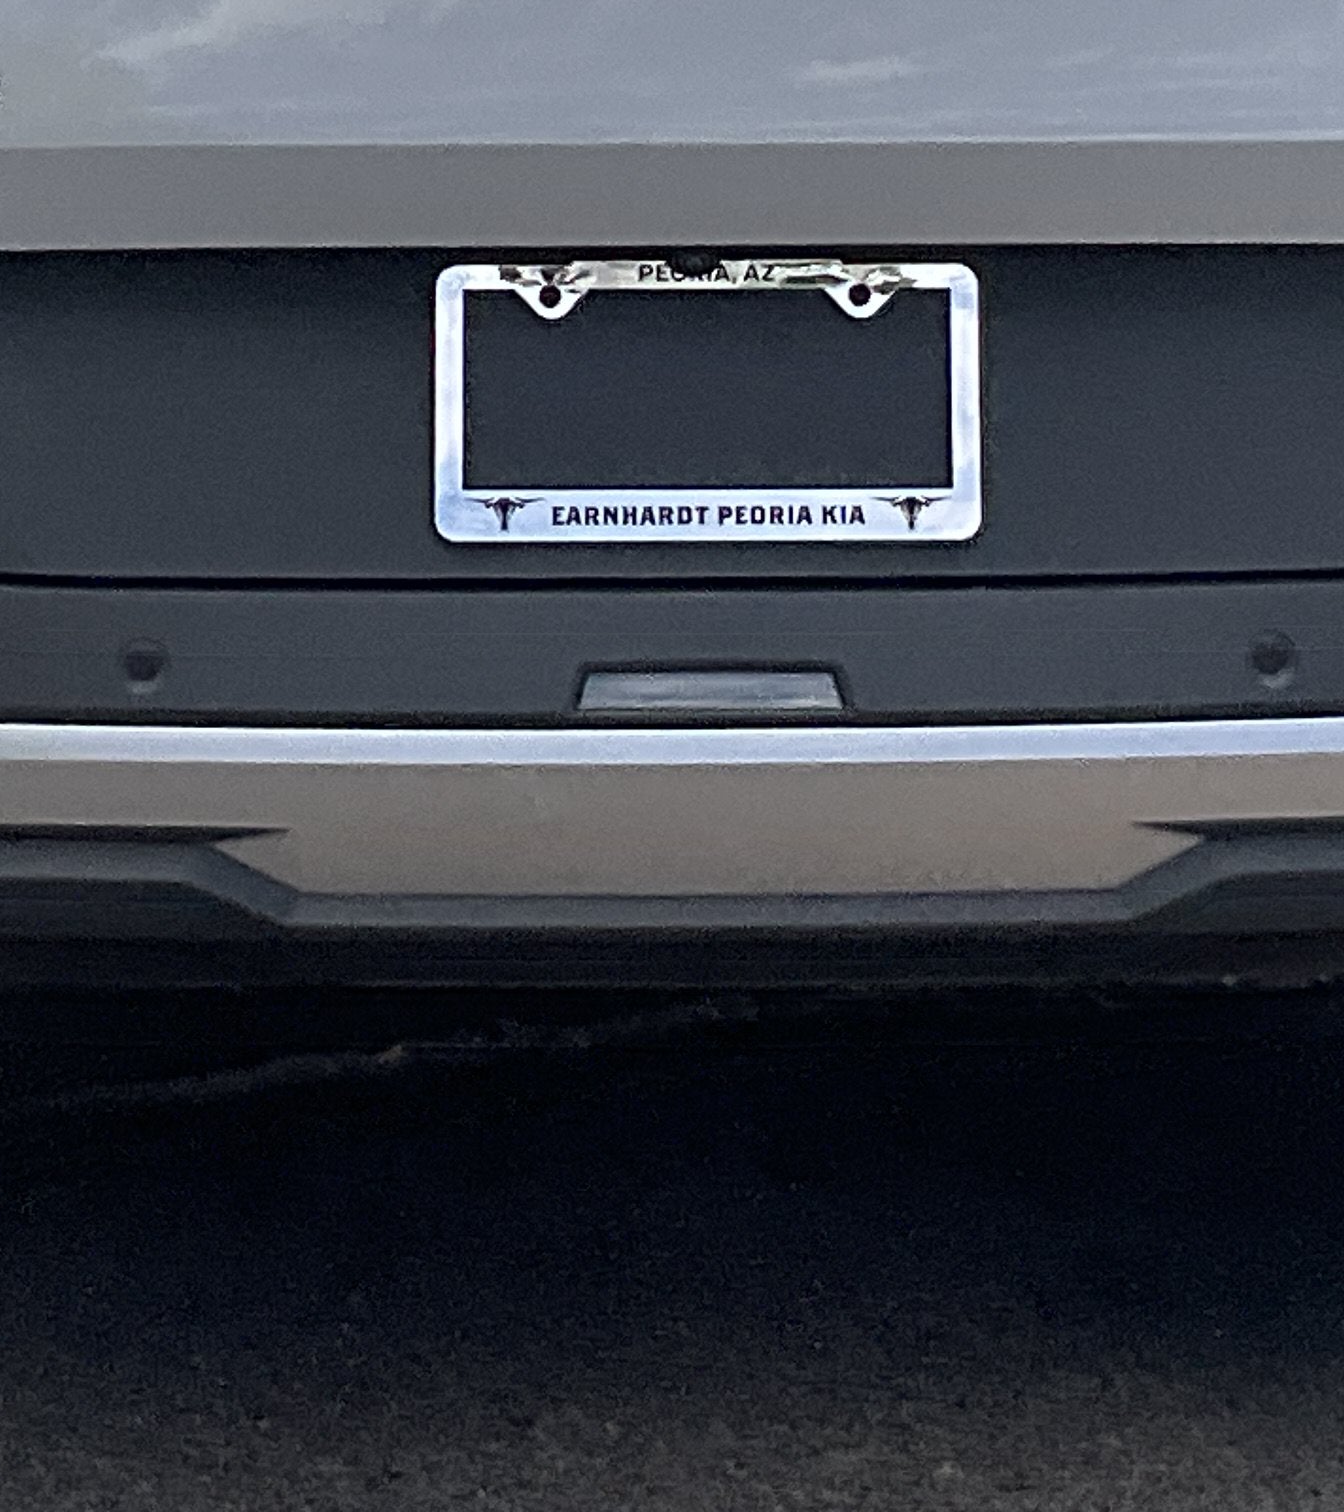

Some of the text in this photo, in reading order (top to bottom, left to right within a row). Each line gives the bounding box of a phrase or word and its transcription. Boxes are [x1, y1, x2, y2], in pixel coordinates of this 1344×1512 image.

[743, 264, 776, 282] AZ
[552, 504, 865, 526] EARNHARDT PEORIA KIA
